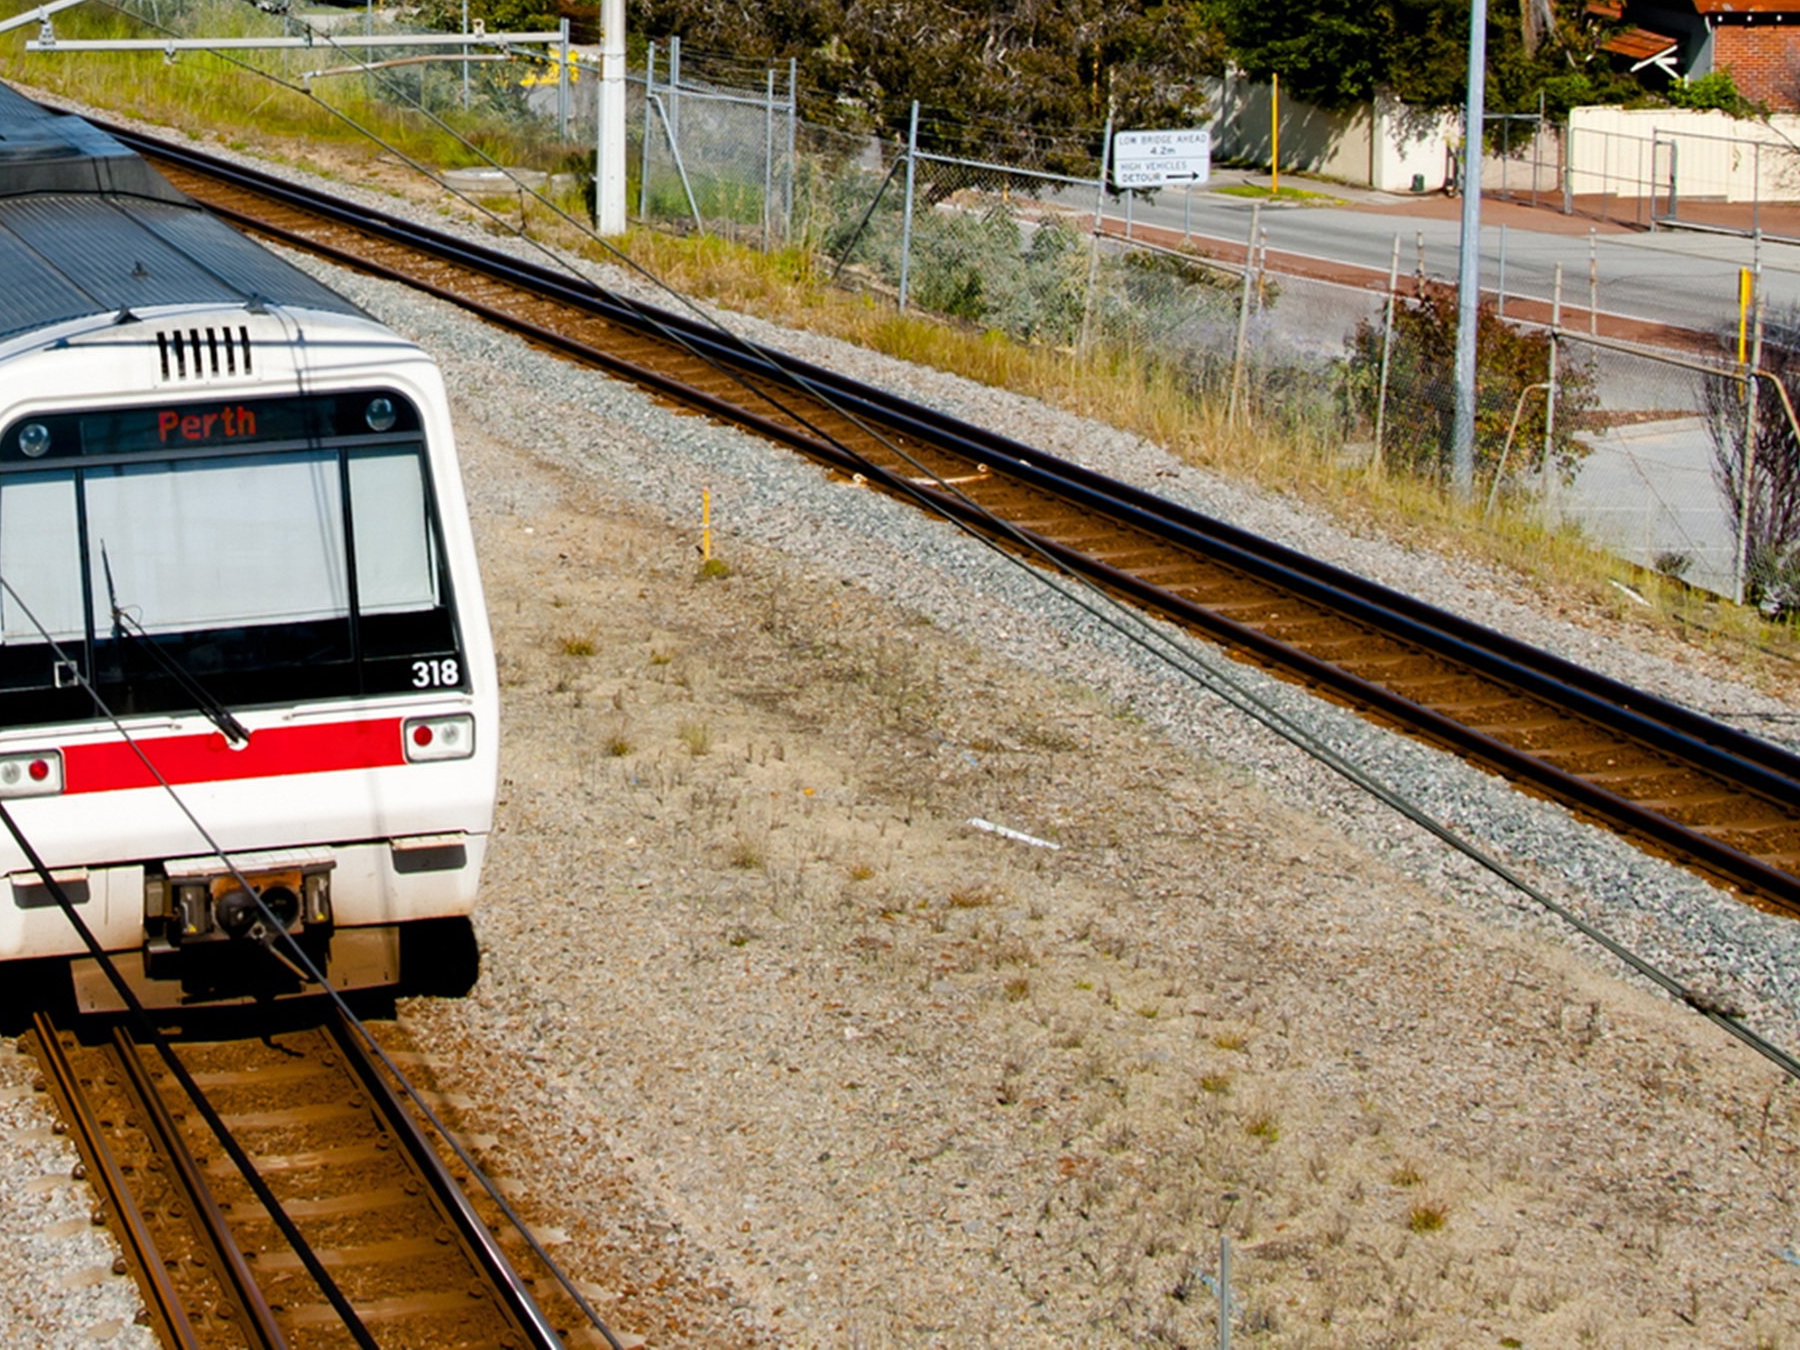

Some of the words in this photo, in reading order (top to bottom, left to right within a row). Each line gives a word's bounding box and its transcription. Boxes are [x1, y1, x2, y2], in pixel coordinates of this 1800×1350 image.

[1119, 136, 1136, 146] LOW
[1141, 135, 1172, 145] BRIDGE
[1176, 134, 1207, 144] AHEAD
[1120, 162, 1141, 172] HIGH
[1145, 161, 1187, 171] VEHICLES
[1122, 173, 1161, 183] DETOUR
[158, 406, 256, 442] Perth
[412, 658, 459, 688] 318
